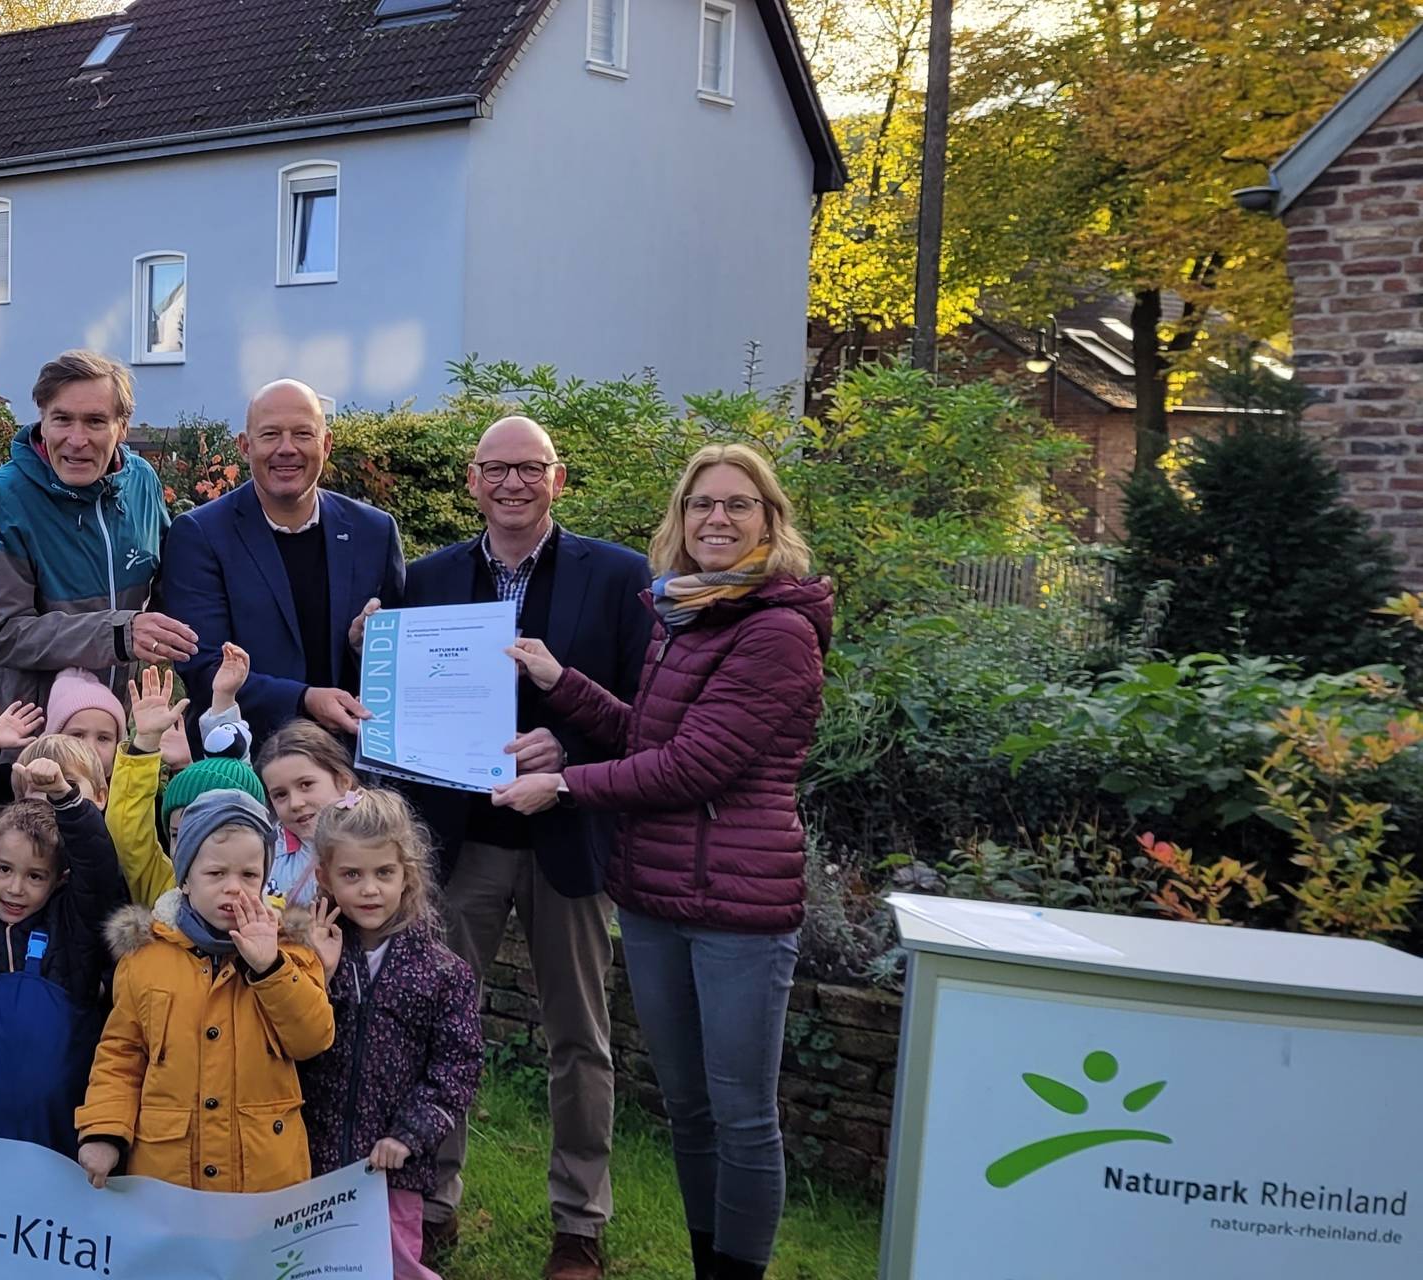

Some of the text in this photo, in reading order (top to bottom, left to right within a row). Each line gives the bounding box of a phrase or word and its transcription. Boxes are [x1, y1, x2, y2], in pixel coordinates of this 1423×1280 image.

[367, 619, 395, 755] URKUNDE
[274, 1188, 357, 1229] NATURPARK
[1104, 1166, 1408, 1217] Naturpark Rheinland
[304, 1210, 334, 1230] KITA
[1210, 1216, 1402, 1245] naturpark-rheinland.de
[290, 1264, 363, 1280] Naturpark Rheinland
